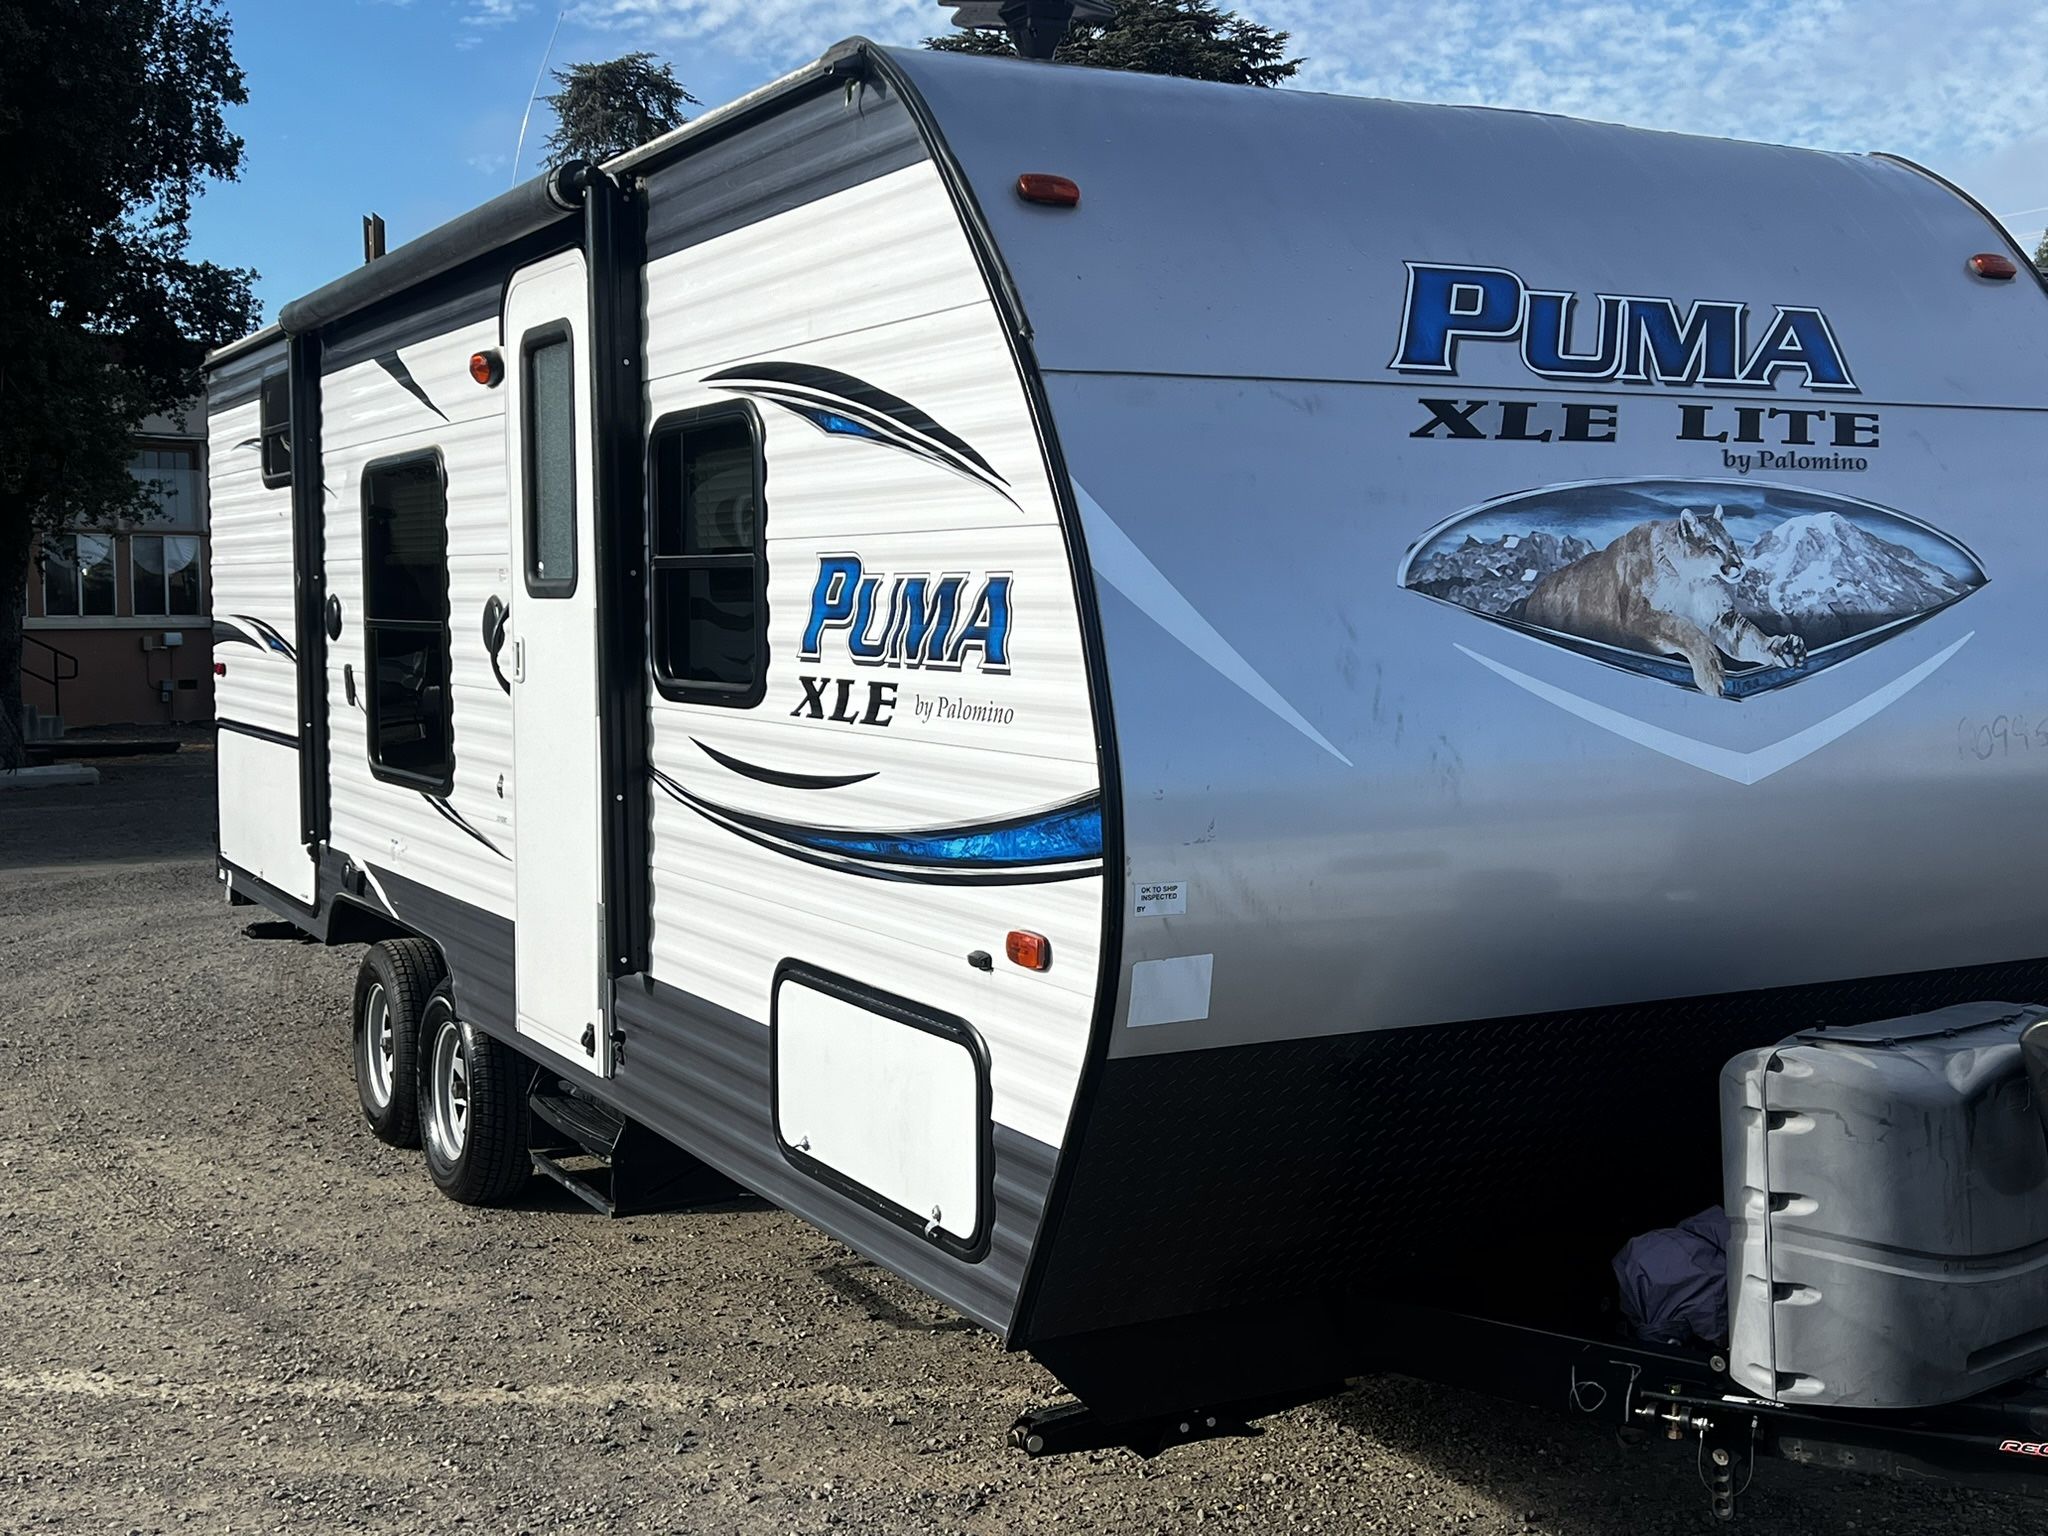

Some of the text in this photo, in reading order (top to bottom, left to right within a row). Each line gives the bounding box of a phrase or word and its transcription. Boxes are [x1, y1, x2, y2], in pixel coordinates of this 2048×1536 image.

[1387, 260, 1861, 393] PUMA
[1409, 398, 1880, 448] XLE LITE
[1722, 449, 1868, 474] by Palomino
[796, 551, 1014, 675] PUMA
[790, 676, 1015, 727] XLE by Palomino
[1141, 886, 1152, 894] OK
[1141, 893, 1178, 901] INSPECTED
